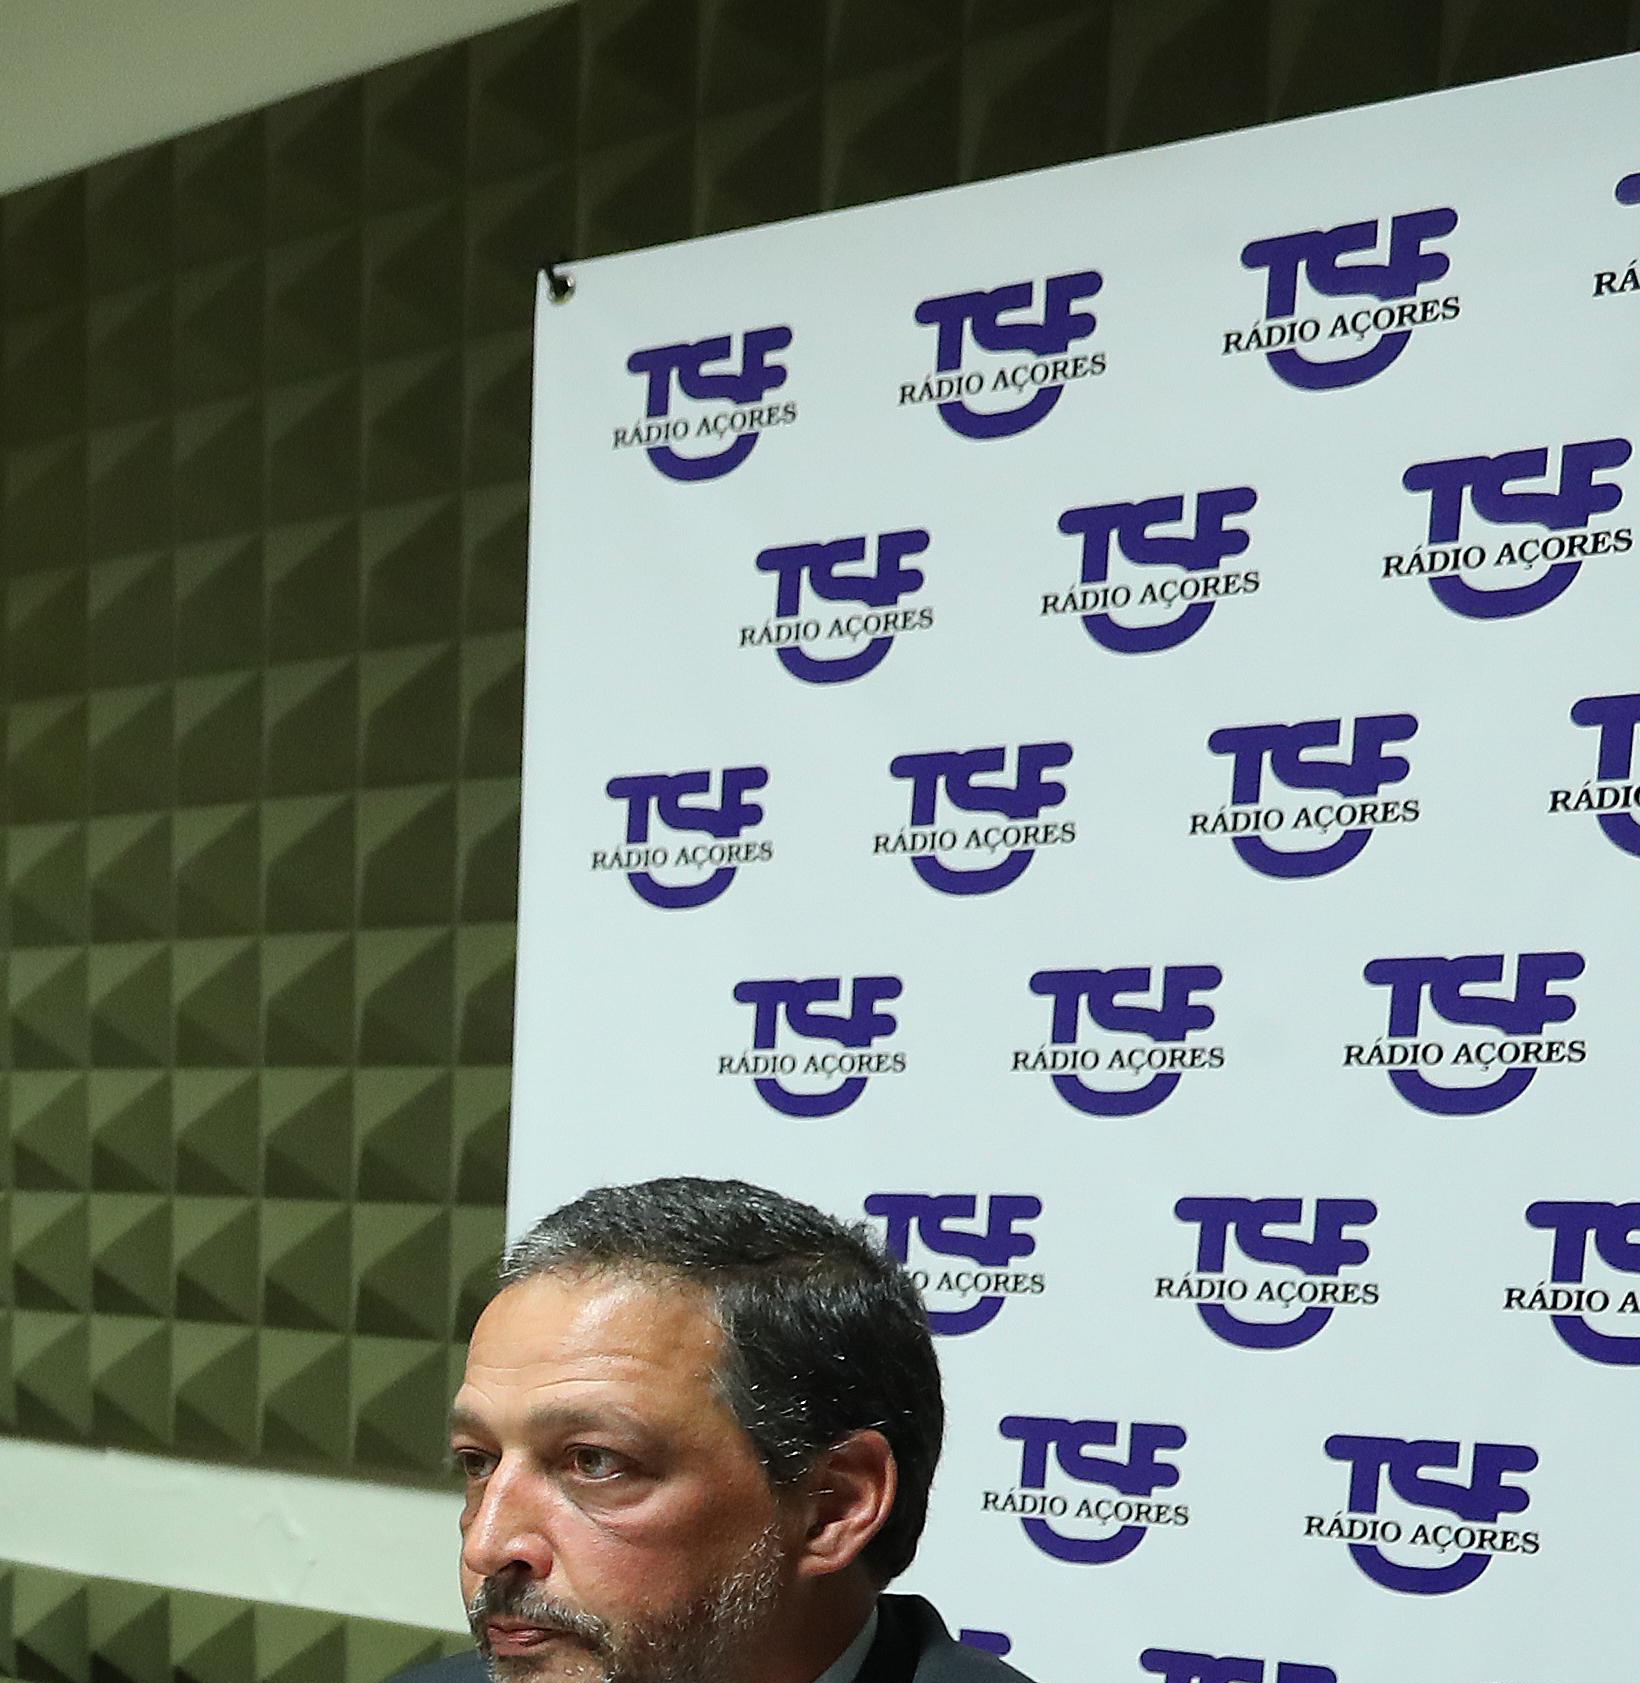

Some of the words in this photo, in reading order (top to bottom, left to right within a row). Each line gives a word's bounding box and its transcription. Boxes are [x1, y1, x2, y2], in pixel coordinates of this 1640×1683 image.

[1240, 207, 1458, 321] TSF
[914, 270, 1103, 375] TSF
[1221, 317, 1321, 356] RÁDIO
[1327, 295, 1461, 342] AÇORES
[627, 325, 793, 419] TSF
[899, 370, 985, 406] RÁDIO
[991, 351, 1107, 394] AÇORES
[613, 419, 690, 449] RÁDIO
[695, 402, 798, 439] AÇORES
[1402, 438, 1632, 546] TSF
[1057, 486, 1258, 585] TSF
[1381, 542, 1487, 579] RÁDIO
[1493, 527, 1633, 571] AÇORES
[755, 529, 930, 619] TSF
[1040, 583, 1132, 617] RÁDIO
[1138, 570, 1261, 609] AÇORES
[739, 619, 821, 648] RÁDIO
[826, 607, 934, 642] AÇORES
[890, 742, 1073, 828] TSF
[1208, 713, 1419, 806] TSF
[606, 766, 769, 845] TSF
[1189, 803, 1285, 836] RÁDIO
[1291, 799, 1420, 835] AÇORES
[1547, 779, 1640, 814] RÁDI
[591, 847, 669, 871] RÁDIO
[674, 841, 773, 869] AÇORES
[873, 829, 958, 854] RÁDIO
[964, 822, 1076, 854] AÇORES
[733, 976, 903, 1050] TSF
[1029, 965, 1223, 1045] TSF
[1363, 952, 1585, 1039] TSF
[718, 1050, 797, 1075] RÁDIO
[803, 1052, 907, 1079] AÇORES
[1011, 1042, 1100, 1072] RÁDIO
[1106, 1046, 1225, 1076] AÇORES
[1342, 1035, 1444, 1067] RÁDIO
[1450, 1039, 1587, 1072] AÇORES
[864, 1194, 1042, 1267] TSF
[1174, 1197, 1378, 1277] TSF
[937, 1271, 1045, 1297] AÇORES
[1154, 1270, 1249, 1301] RÁDIO
[1253, 1280, 1380, 1309] AÇORES
[1503, 1280, 1610, 1312] RÁDIO
[999, 1415, 1187, 1498] TSF
[1324, 1434, 1539, 1524] TSF
[980, 1485, 1068, 1517] RÁDIO
[1074, 1498, 1190, 1527] AÇORES
[1303, 1509, 1403, 1544] RÁDIO
[1407, 1523, 1540, 1555] AÇORES
